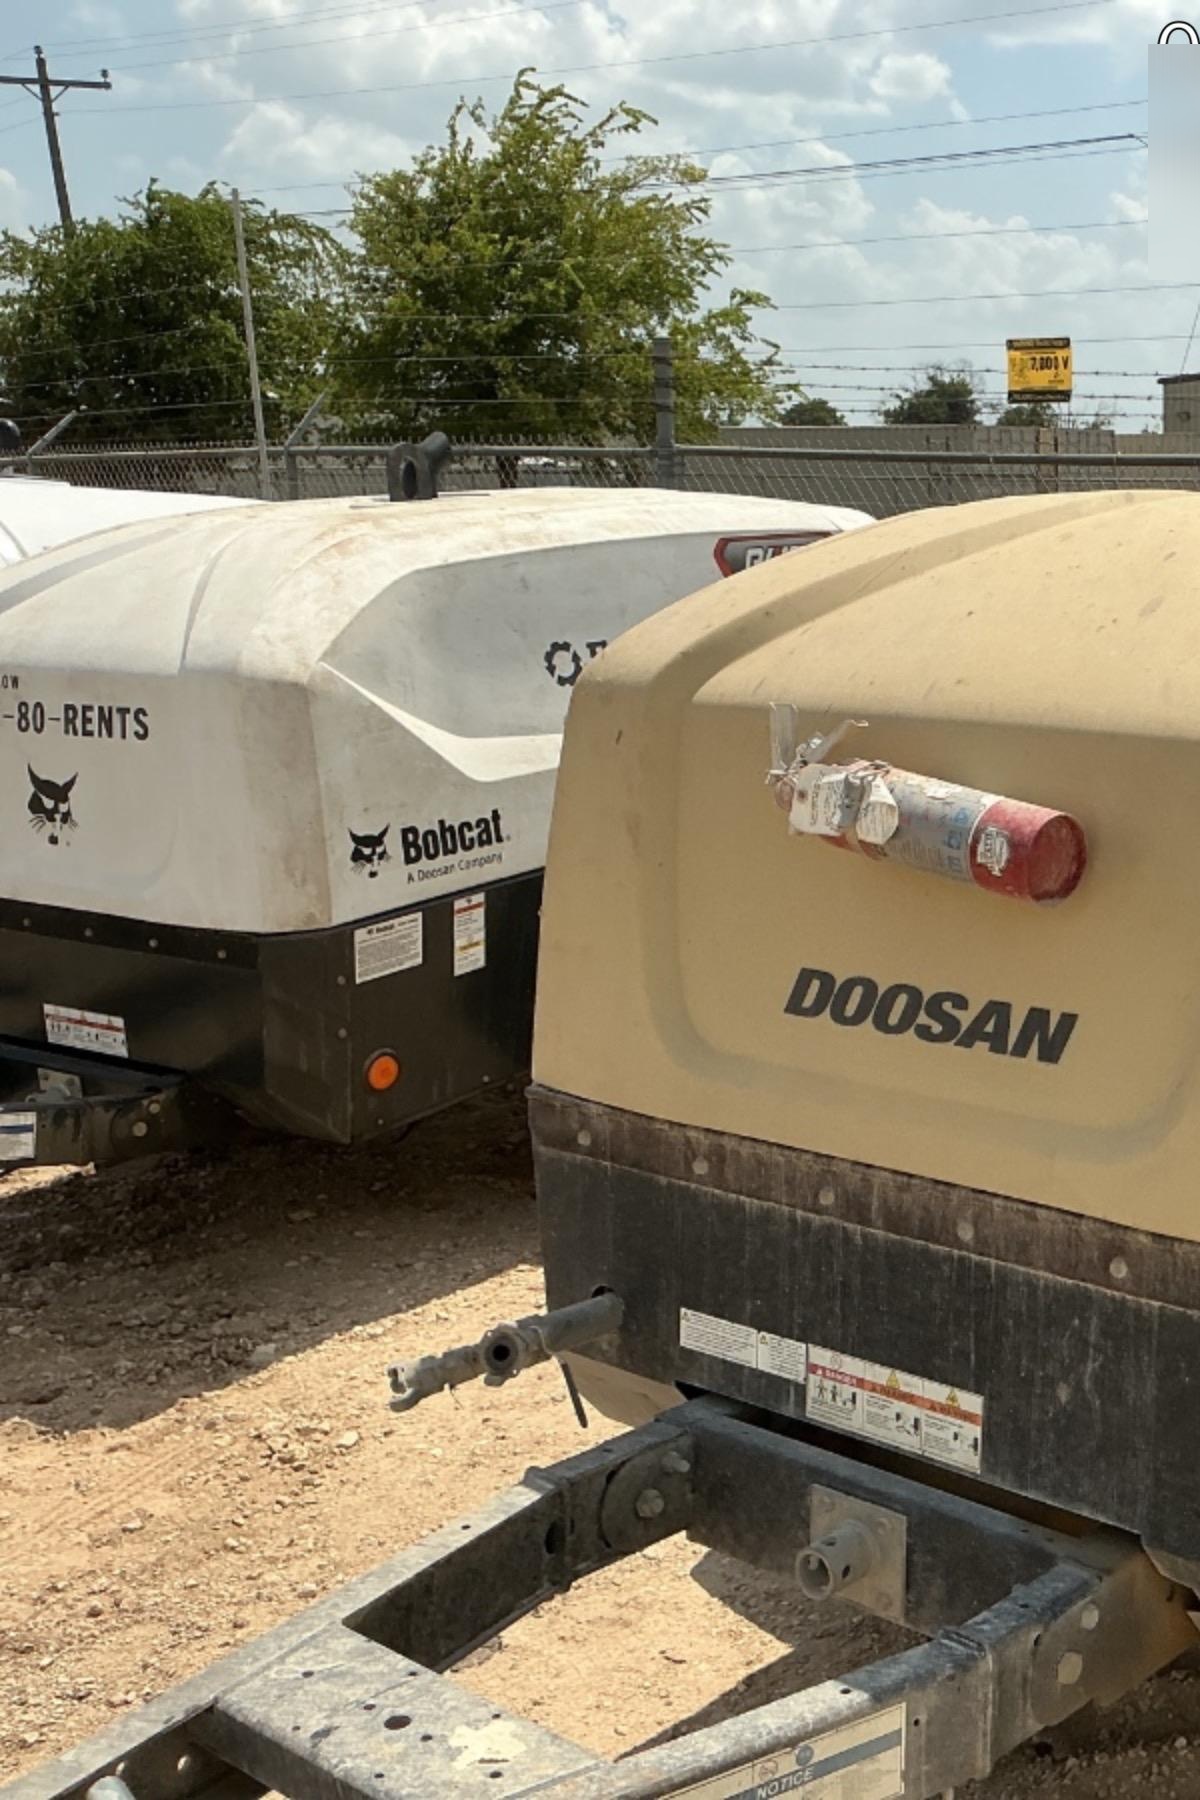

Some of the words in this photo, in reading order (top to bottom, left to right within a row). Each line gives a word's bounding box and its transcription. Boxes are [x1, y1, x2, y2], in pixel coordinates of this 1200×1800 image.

[0, 674, 19, 690] OW
[400, 808, 504, 866] Bobcat
[407, 871, 416, 885] A
[417, 863, 455, 882] Doosan
[458, 851, 503, 871] Company
[783, 967, 1079, 1065] DOOSAN
[757, 1768, 814, 1799] NOTICE
